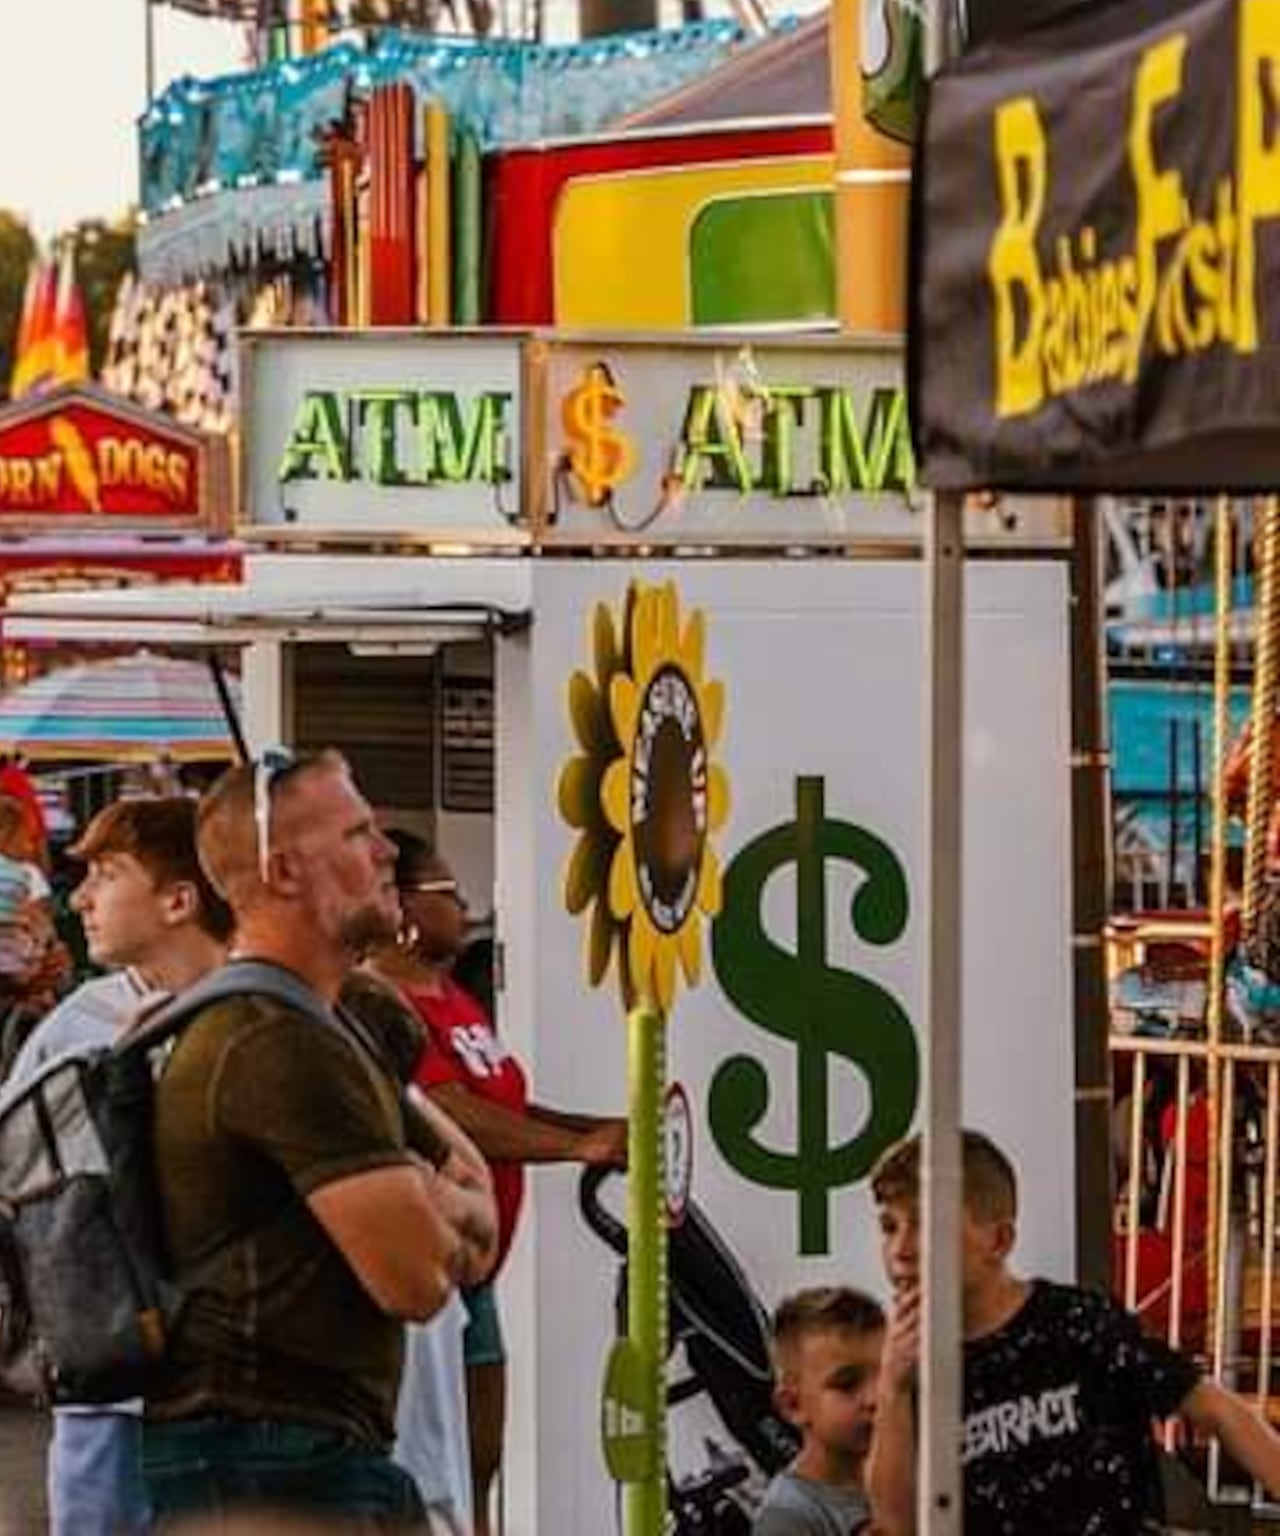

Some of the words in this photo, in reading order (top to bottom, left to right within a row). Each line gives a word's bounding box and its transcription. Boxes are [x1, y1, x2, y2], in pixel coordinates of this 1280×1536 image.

[96, 435, 192, 505] DOGS
[278, 390, 512, 486] ATM
[677, 384, 918, 496] ATM
